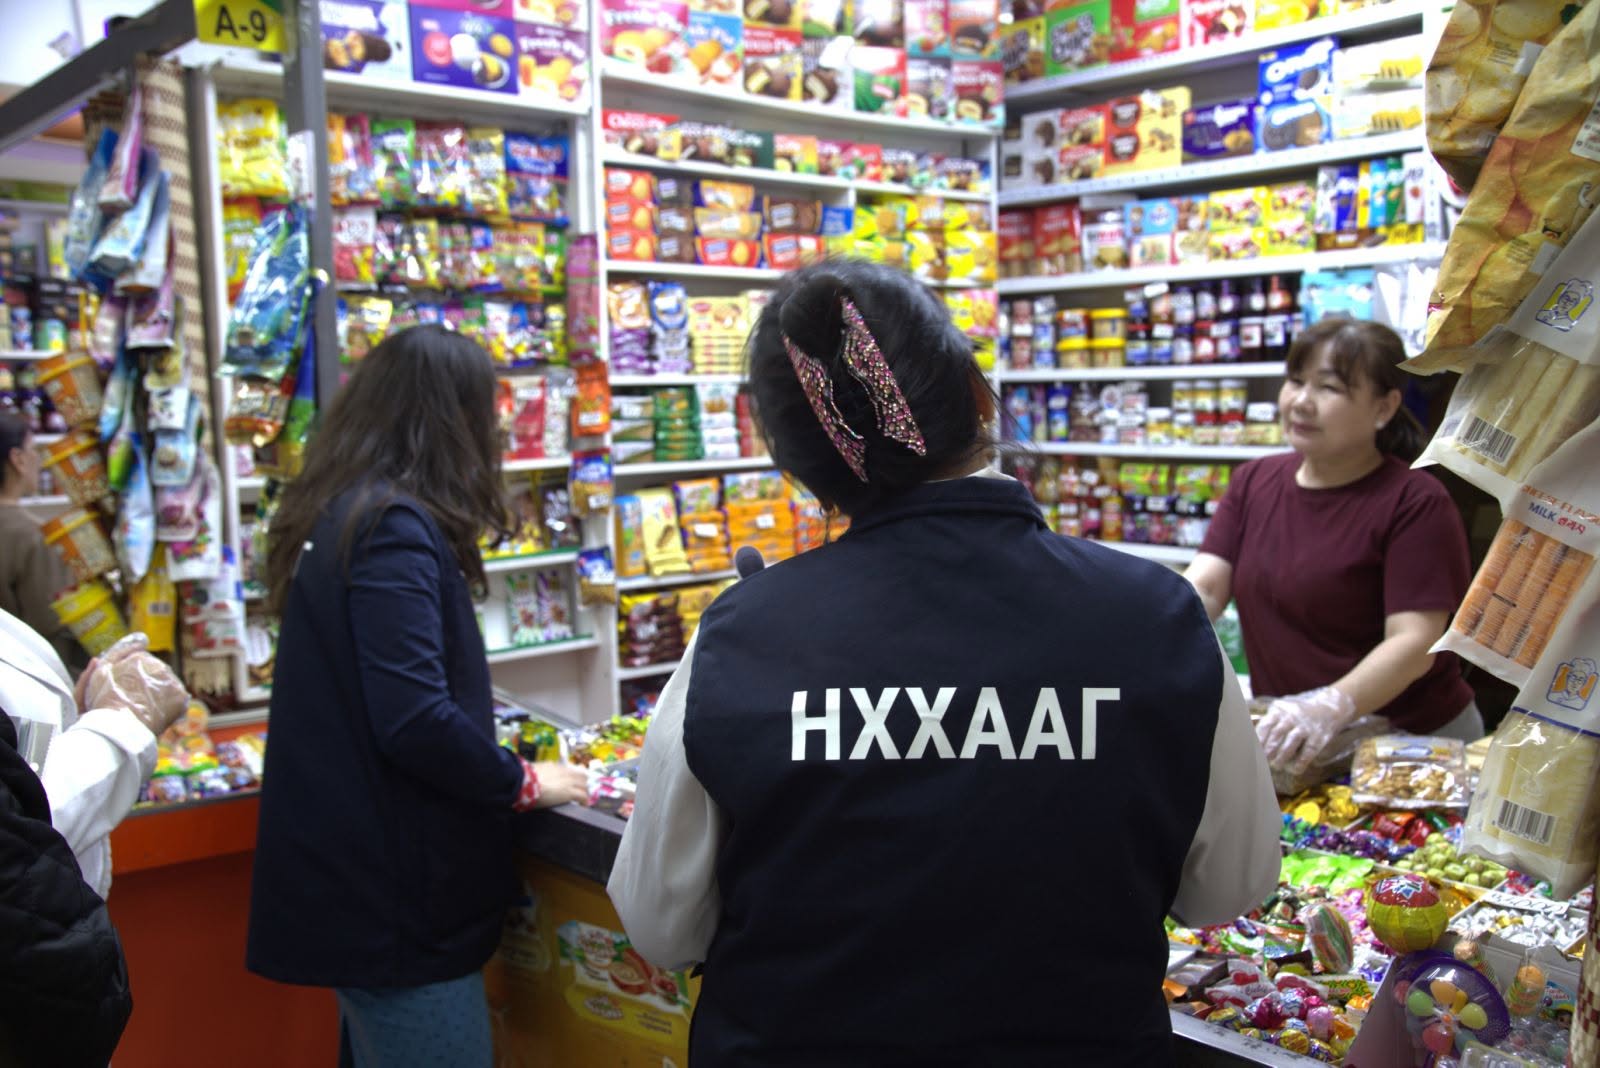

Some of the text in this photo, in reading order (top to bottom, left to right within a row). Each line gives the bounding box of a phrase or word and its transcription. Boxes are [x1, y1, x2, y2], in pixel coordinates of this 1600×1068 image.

[215, 5, 266, 42] A-9
[1528, 502, 1557, 522] MILK
[791, 687, 1121, 761] НХХААГ
